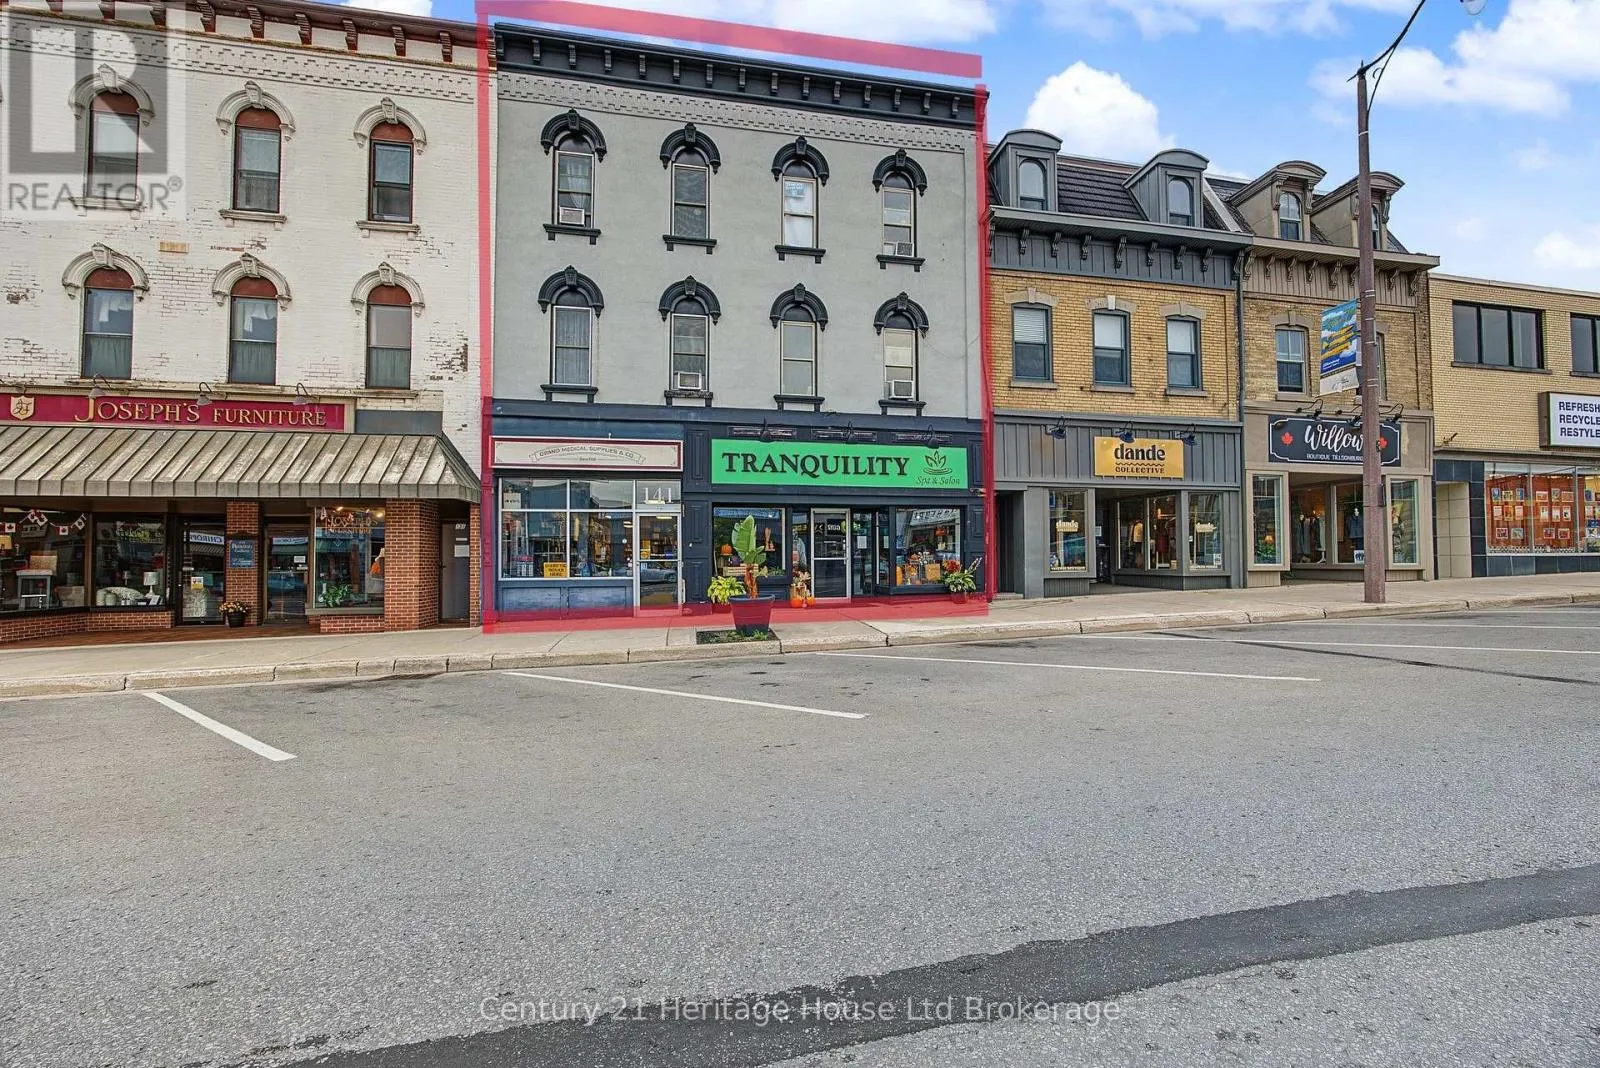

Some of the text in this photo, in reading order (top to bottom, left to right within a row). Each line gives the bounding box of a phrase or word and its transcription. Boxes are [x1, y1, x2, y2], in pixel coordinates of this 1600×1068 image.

[1558, 401, 1600, 413] REFRESH
[213, 407, 326, 426] FURNITURE
[1559, 414, 1600, 426] RECYCLE
[1304, 424, 1364, 453] Willow
[1560, 427, 1600, 438] RESTYLE
[539, 448, 561, 457] GRAND
[561, 445, 587, 453] MEDICAL
[589, 446, 618, 455] SUPPLIES
[1114, 443, 1166, 461] dande
[1332, 454, 1364, 462] TILLSONBURG
[721, 452, 910, 479] TRANQUILITY
[1115, 466, 1165, 474] COLLECTIVE
[916, 475, 961, 486] Spa & Salon
[643, 487, 674, 504] 141
